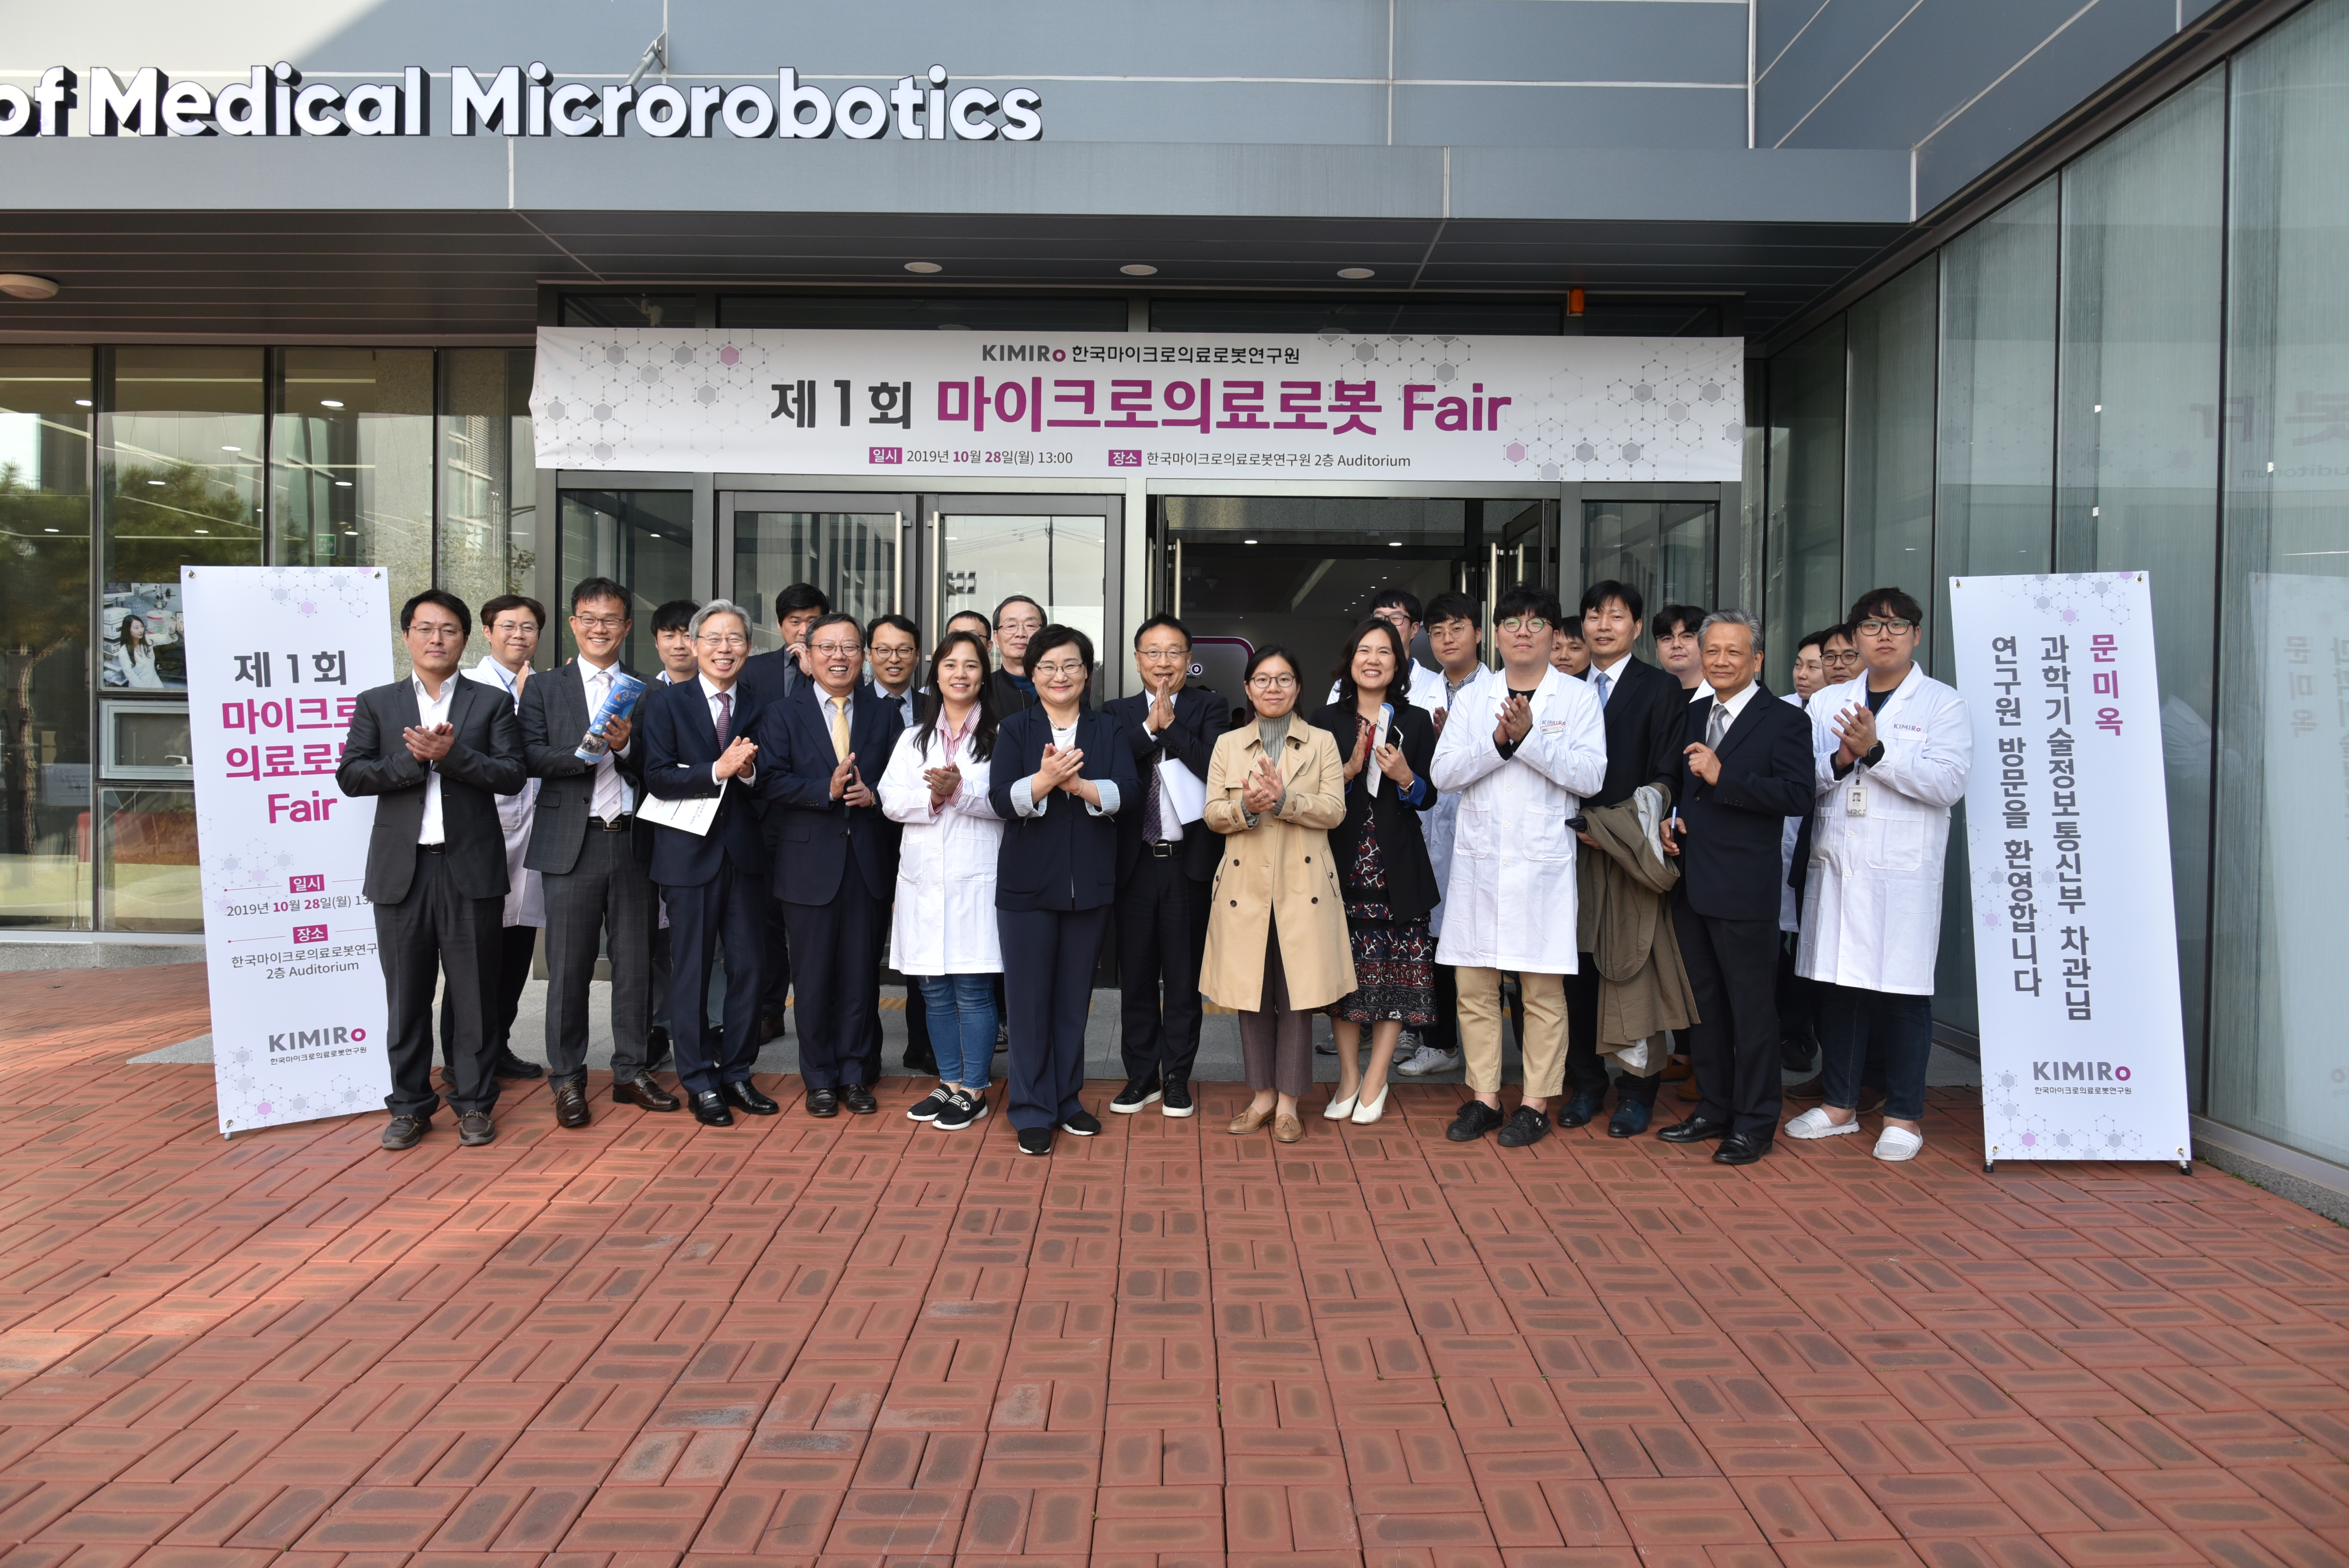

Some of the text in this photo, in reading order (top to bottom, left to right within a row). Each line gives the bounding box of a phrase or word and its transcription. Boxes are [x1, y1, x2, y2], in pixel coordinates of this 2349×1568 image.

[89, 61, 426, 137] Medical
[451, 61, 1043, 141] Microrobotics
[1072, 345, 1299, 364] 한국마이크로의료로봇연구원
[937, 376, 1382, 436] 마이크로의료로봇
[1403, 383, 1512, 431] Fair
[873, 449, 897, 463] 일시
[907, 449, 1073, 466] 2019년 10월 28일(월) 13:00
[1113, 451, 1138, 465] 장소
[1147, 452, 1410, 467] 한국마이크로의료로봇연구원 2층 Auditorium
[226, 742, 347, 781] 의료로
[267, 790, 338, 824] Fair
[1992, 636, 2042, 997] 연구원 방문을 환영합니다
[2041, 634, 2092, 1021] 과학기술정보통신부 차관님
[293, 876, 321, 892] 일시
[226, 902, 269, 916] 2019년
[273, 899, 301, 912] 10월
[304, 895, 351, 910] 28일(월)
[297, 927, 325, 942] 장소
[231, 943, 378, 968] 한국마이크로의료로봇연구
[266, 962, 359, 979] 2층 Auditorium
[271, 1046, 367, 1066] 한국마이크로의료로봇연구원
[2034, 1087, 2132, 1095] 한국마이크로의료로봇연구원
